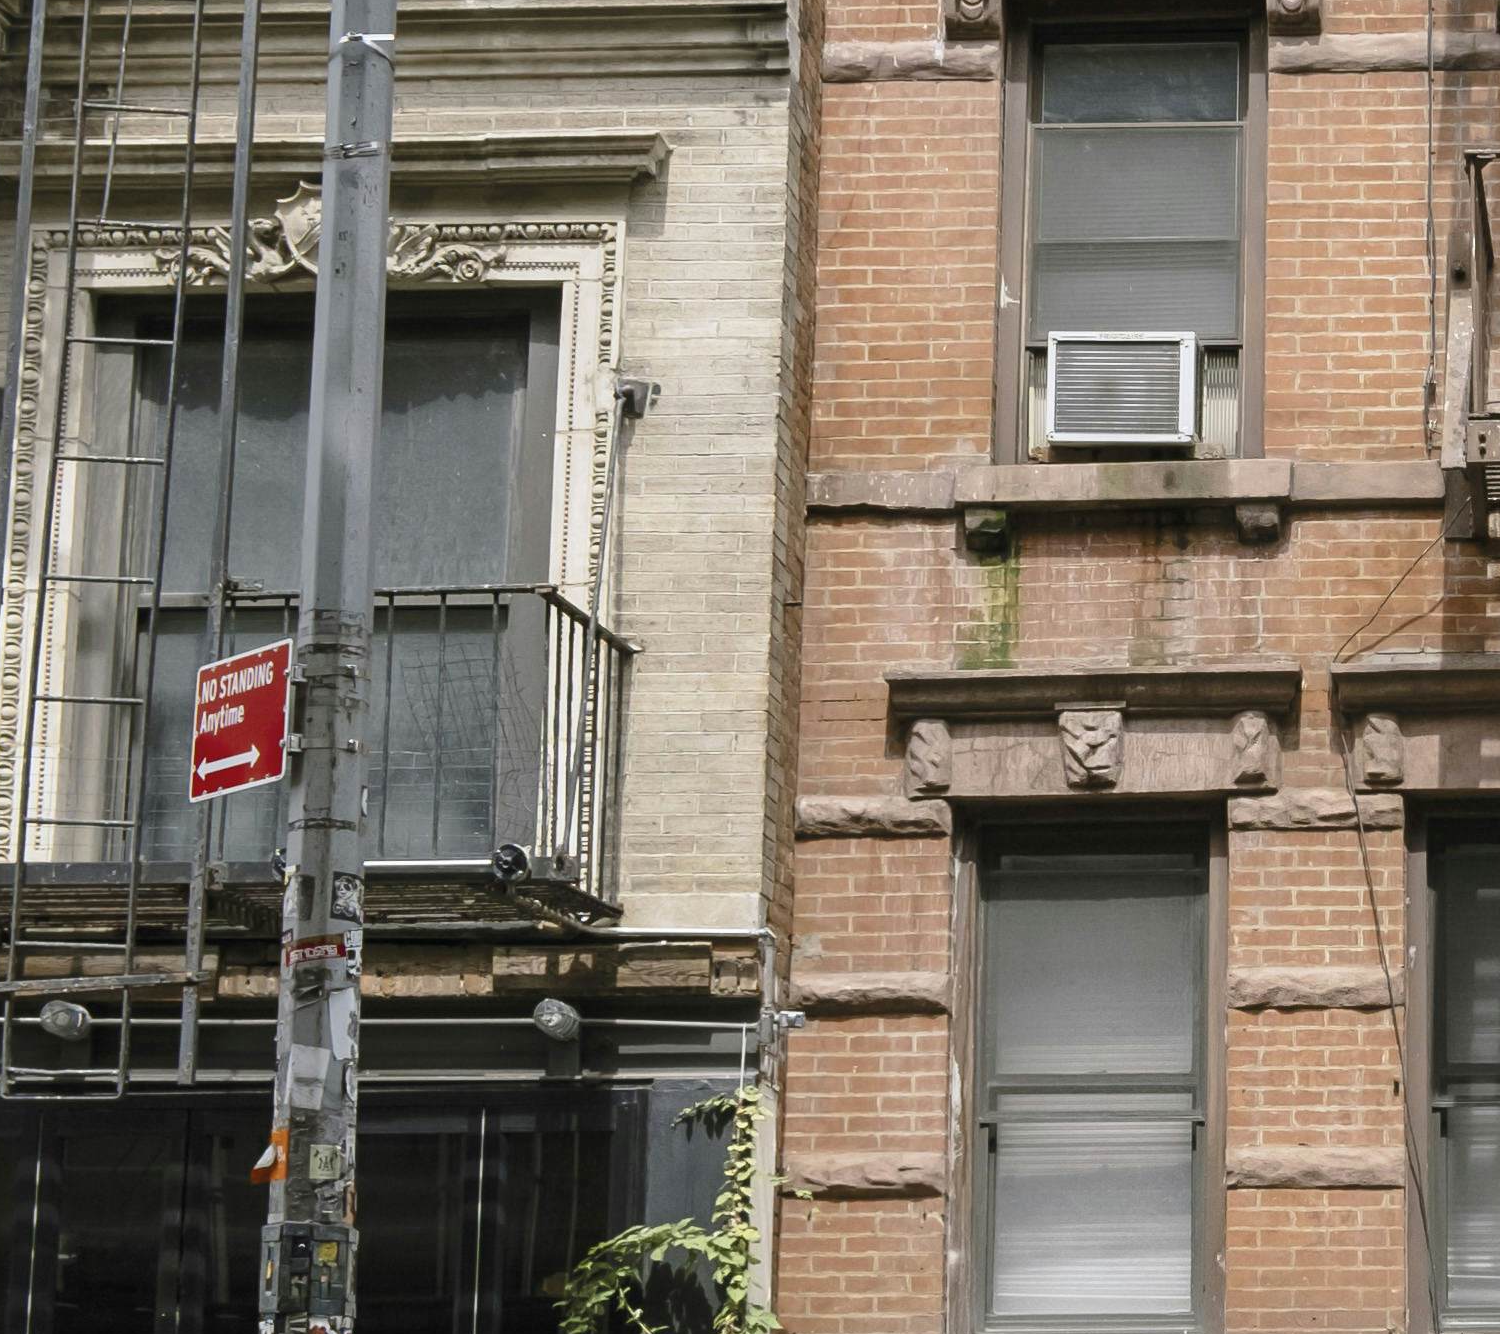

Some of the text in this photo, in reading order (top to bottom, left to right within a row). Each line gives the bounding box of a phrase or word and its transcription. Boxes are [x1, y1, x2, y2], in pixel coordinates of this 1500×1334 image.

[201, 661, 274, 704] NO STANDING
[200, 703, 244, 736] Anytime
